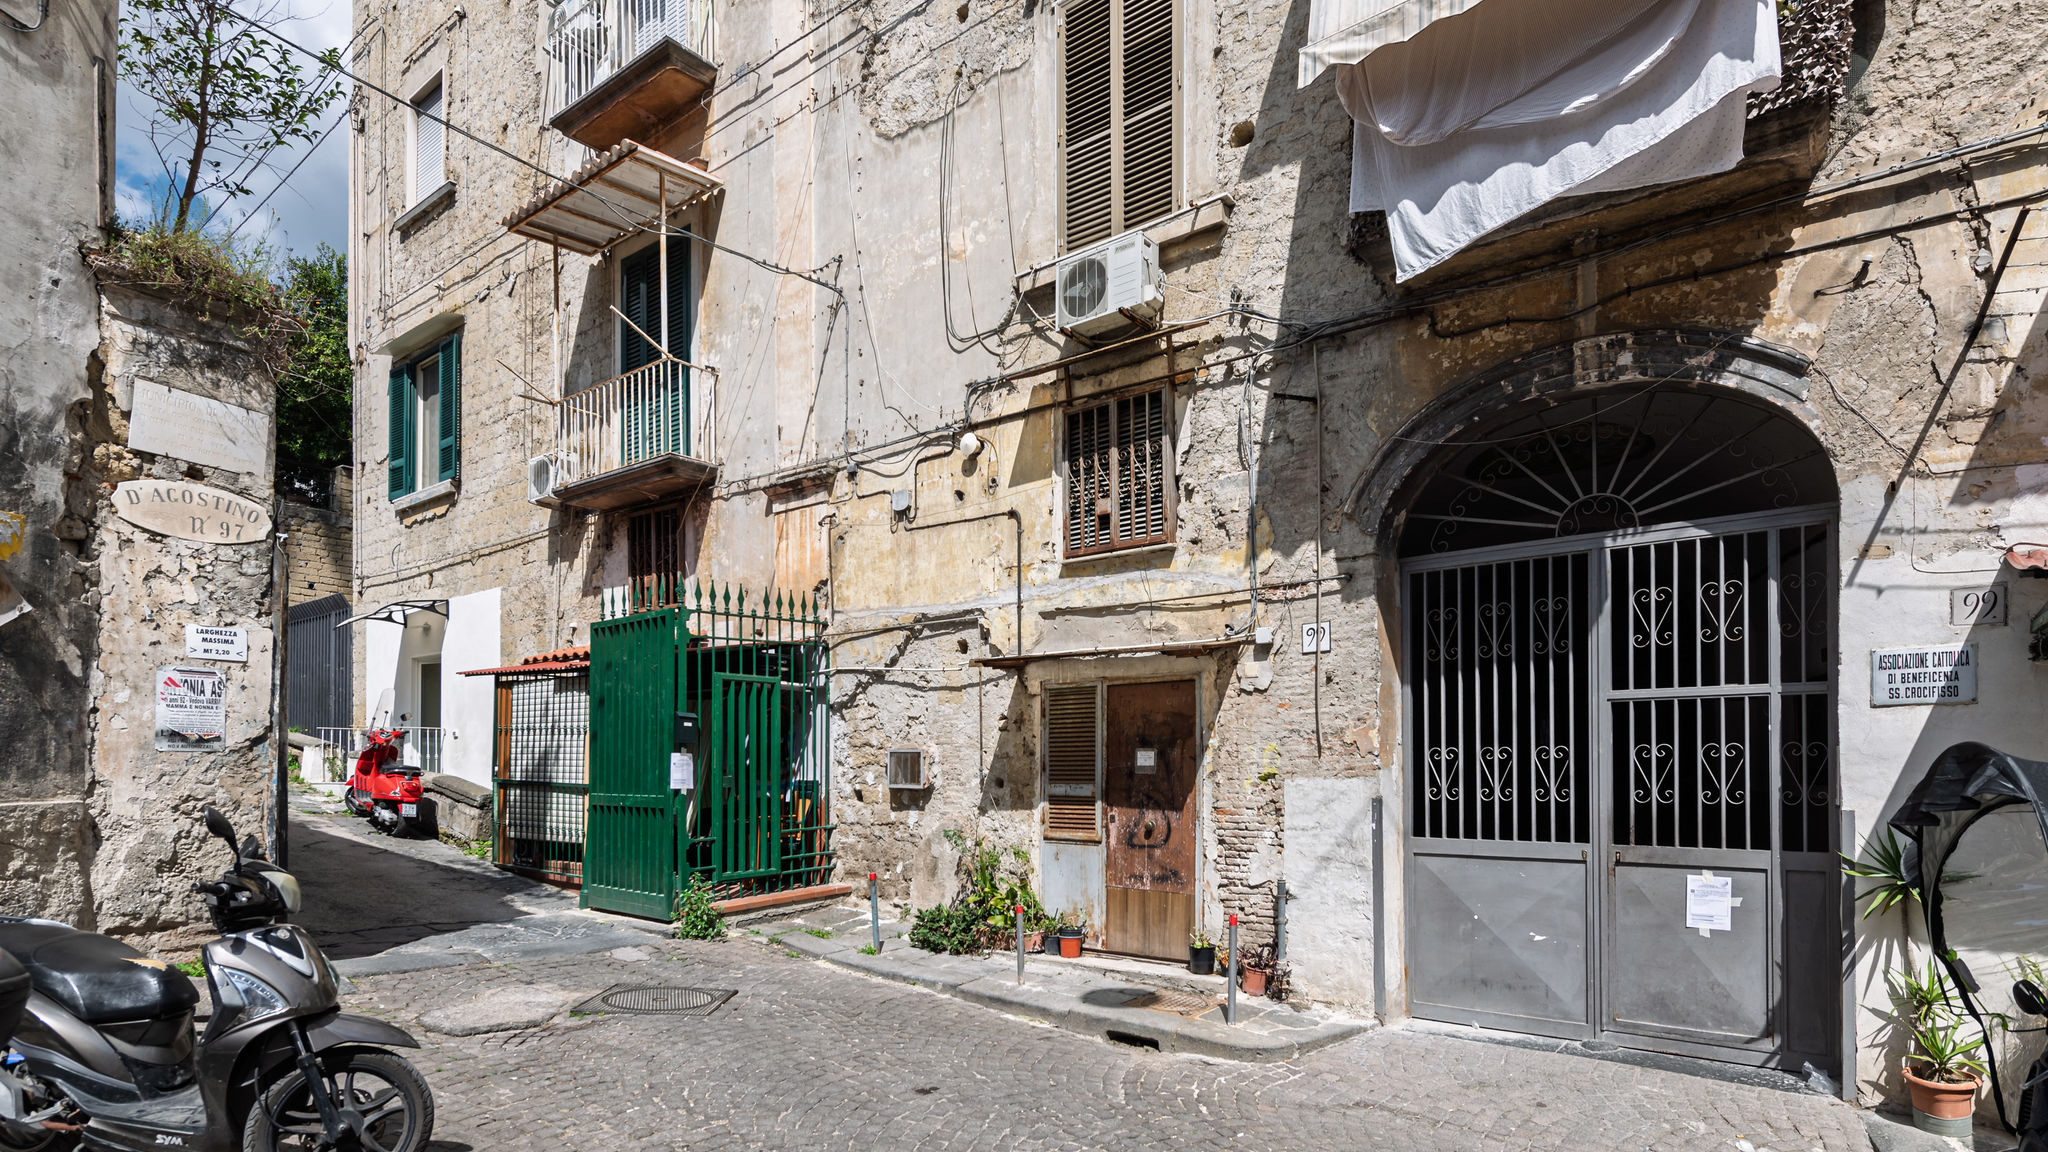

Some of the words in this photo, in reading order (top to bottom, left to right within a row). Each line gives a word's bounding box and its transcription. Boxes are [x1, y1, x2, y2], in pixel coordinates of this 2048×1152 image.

[220, 521, 244, 541] 97
[196, 628, 238, 637] LARGHEZZA
[201, 637, 235, 645] MASSIMA
[215, 648, 231, 656] 2,20
[1879, 653, 1929, 670] ASSOCIAZIONE
[1932, 650, 1970, 668] CATTOLICA
[1888, 673, 1896, 685] DI
[1901, 671, 1960, 684] BENEFICENZA
[155, 1134, 183, 1146] SYM
